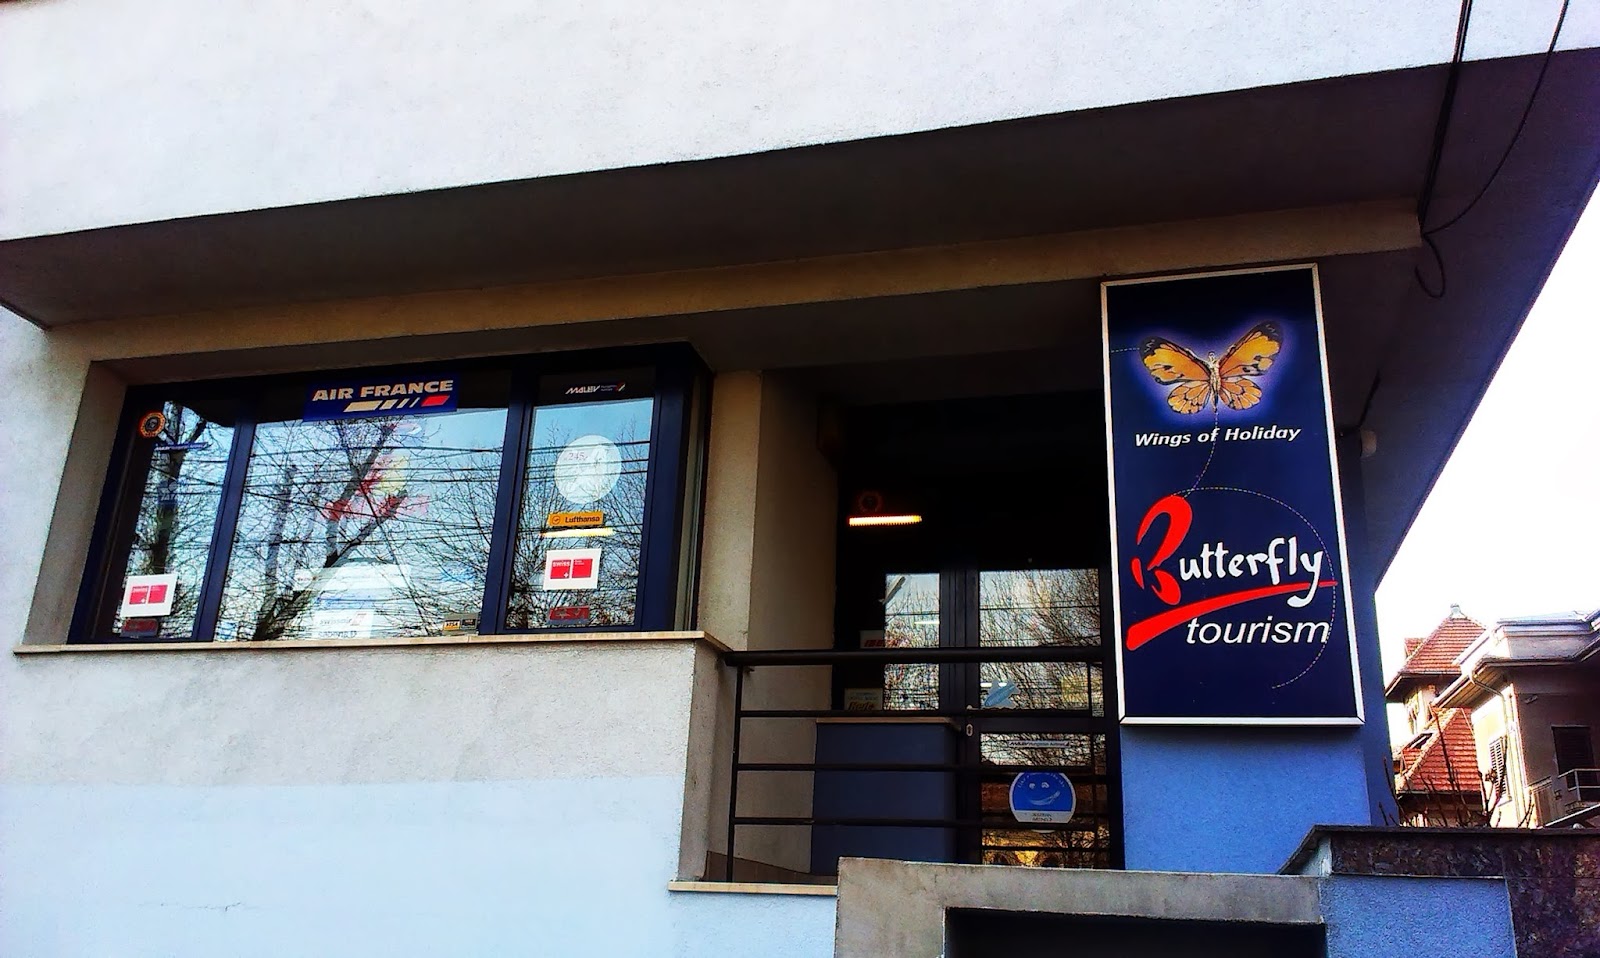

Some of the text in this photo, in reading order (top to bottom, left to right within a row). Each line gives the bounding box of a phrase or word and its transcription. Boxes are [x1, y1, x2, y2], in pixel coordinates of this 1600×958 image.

[312, 379, 454, 402] AIR FRANCE
[1135, 424, 1302, 448] Wings of Holiday
[564, 515, 601, 524] Lufthansa
[1131, 494, 1324, 608] Butterfly
[1185, 615, 1330, 644] tourism
